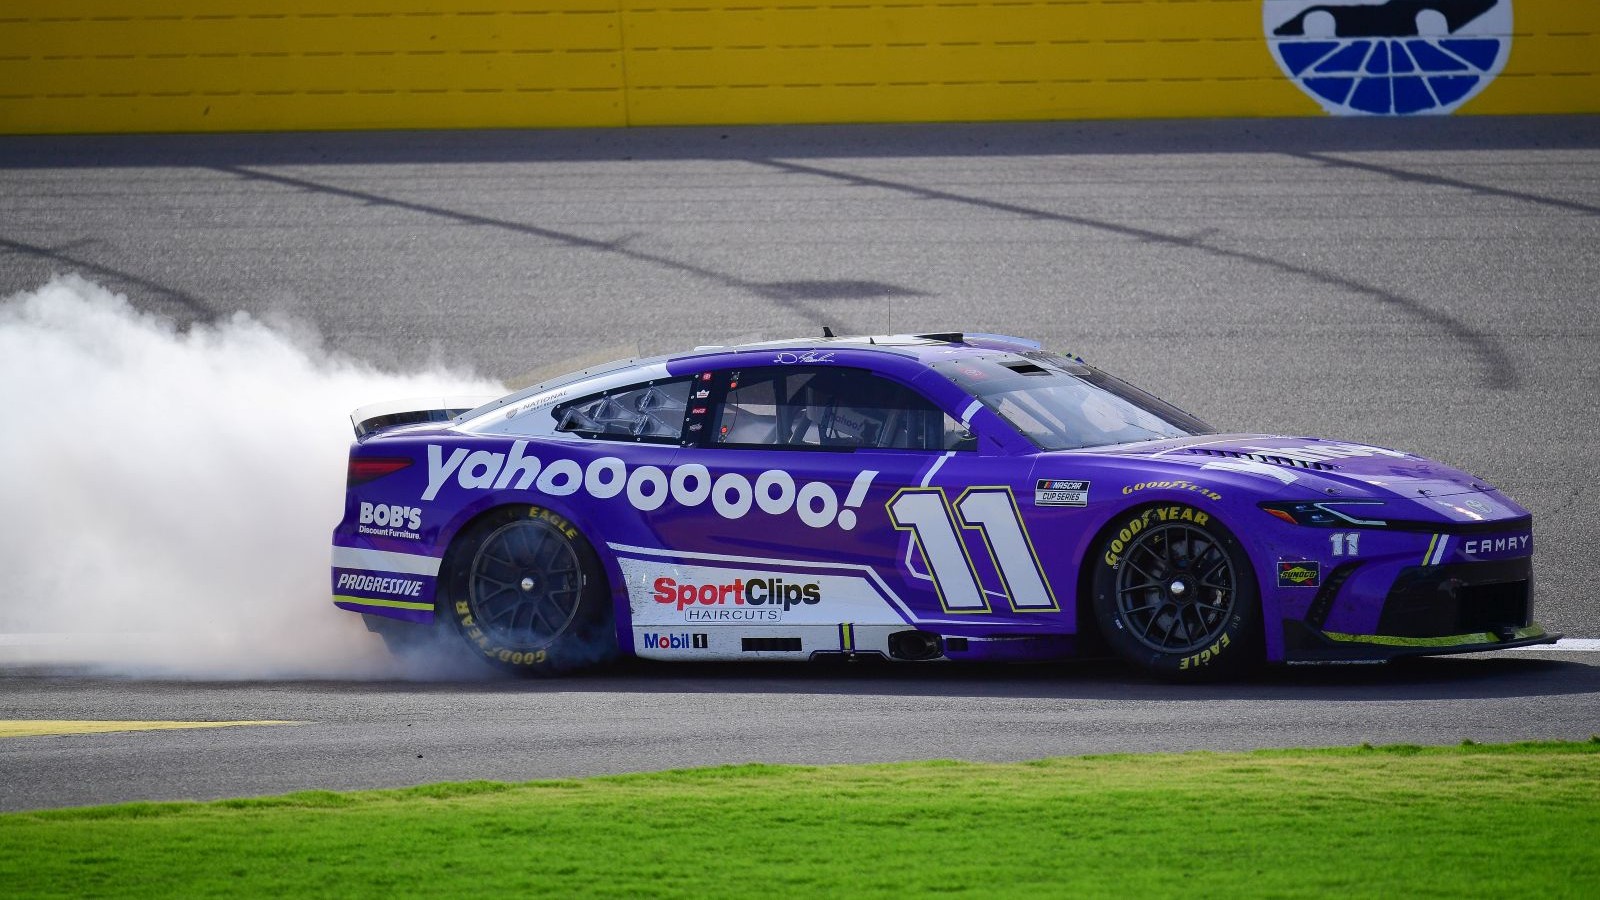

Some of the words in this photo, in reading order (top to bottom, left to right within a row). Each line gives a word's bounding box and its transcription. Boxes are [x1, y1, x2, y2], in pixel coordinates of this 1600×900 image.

[421, 440, 879, 530] yahooooooo!
[1052, 481, 1083, 490] NASCAR
[1122, 480, 1222, 501] GOODYEAR
[1042, 492, 1057, 500] CUP
[1057, 492, 1081, 501] SERIES
[360, 501, 422, 530] BOB'S
[528, 506, 578, 539] EAGLE
[359, 525, 389, 537] Discount
[1104, 506, 1209, 566] GOODYEAR
[885, 485, 1061, 613] 11
[1329, 532, 1360, 556] 11
[1465, 534, 1530, 554] CAMRY
[337, 573, 423, 597] PROGRESSIVE
[1280, 571, 1317, 579] SUNOCO
[689, 610, 778, 620] HAIRCUTS
[644, 633, 690, 649] Mobil
[1179, 632, 1231, 670] EAGLE
